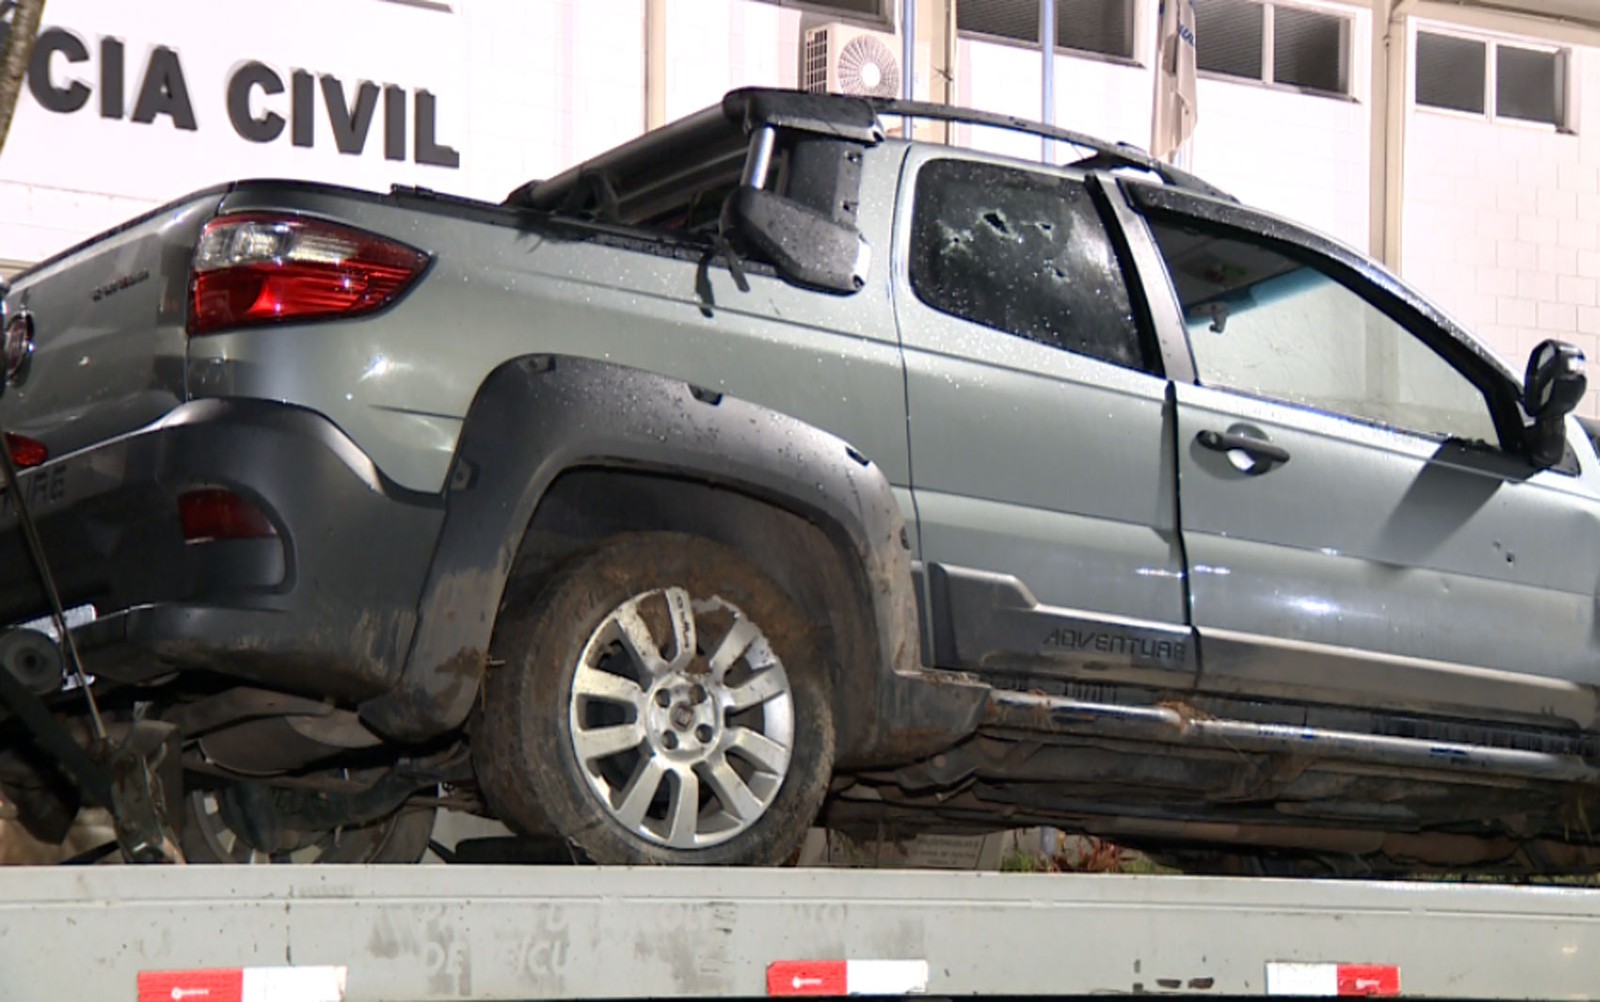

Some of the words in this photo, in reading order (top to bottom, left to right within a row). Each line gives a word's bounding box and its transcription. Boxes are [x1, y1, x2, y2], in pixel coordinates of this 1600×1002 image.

[0, 0, 197, 131] CIA
[227, 60, 460, 169] CIVIL
[1043, 627, 1186, 662] ADVENTURE
